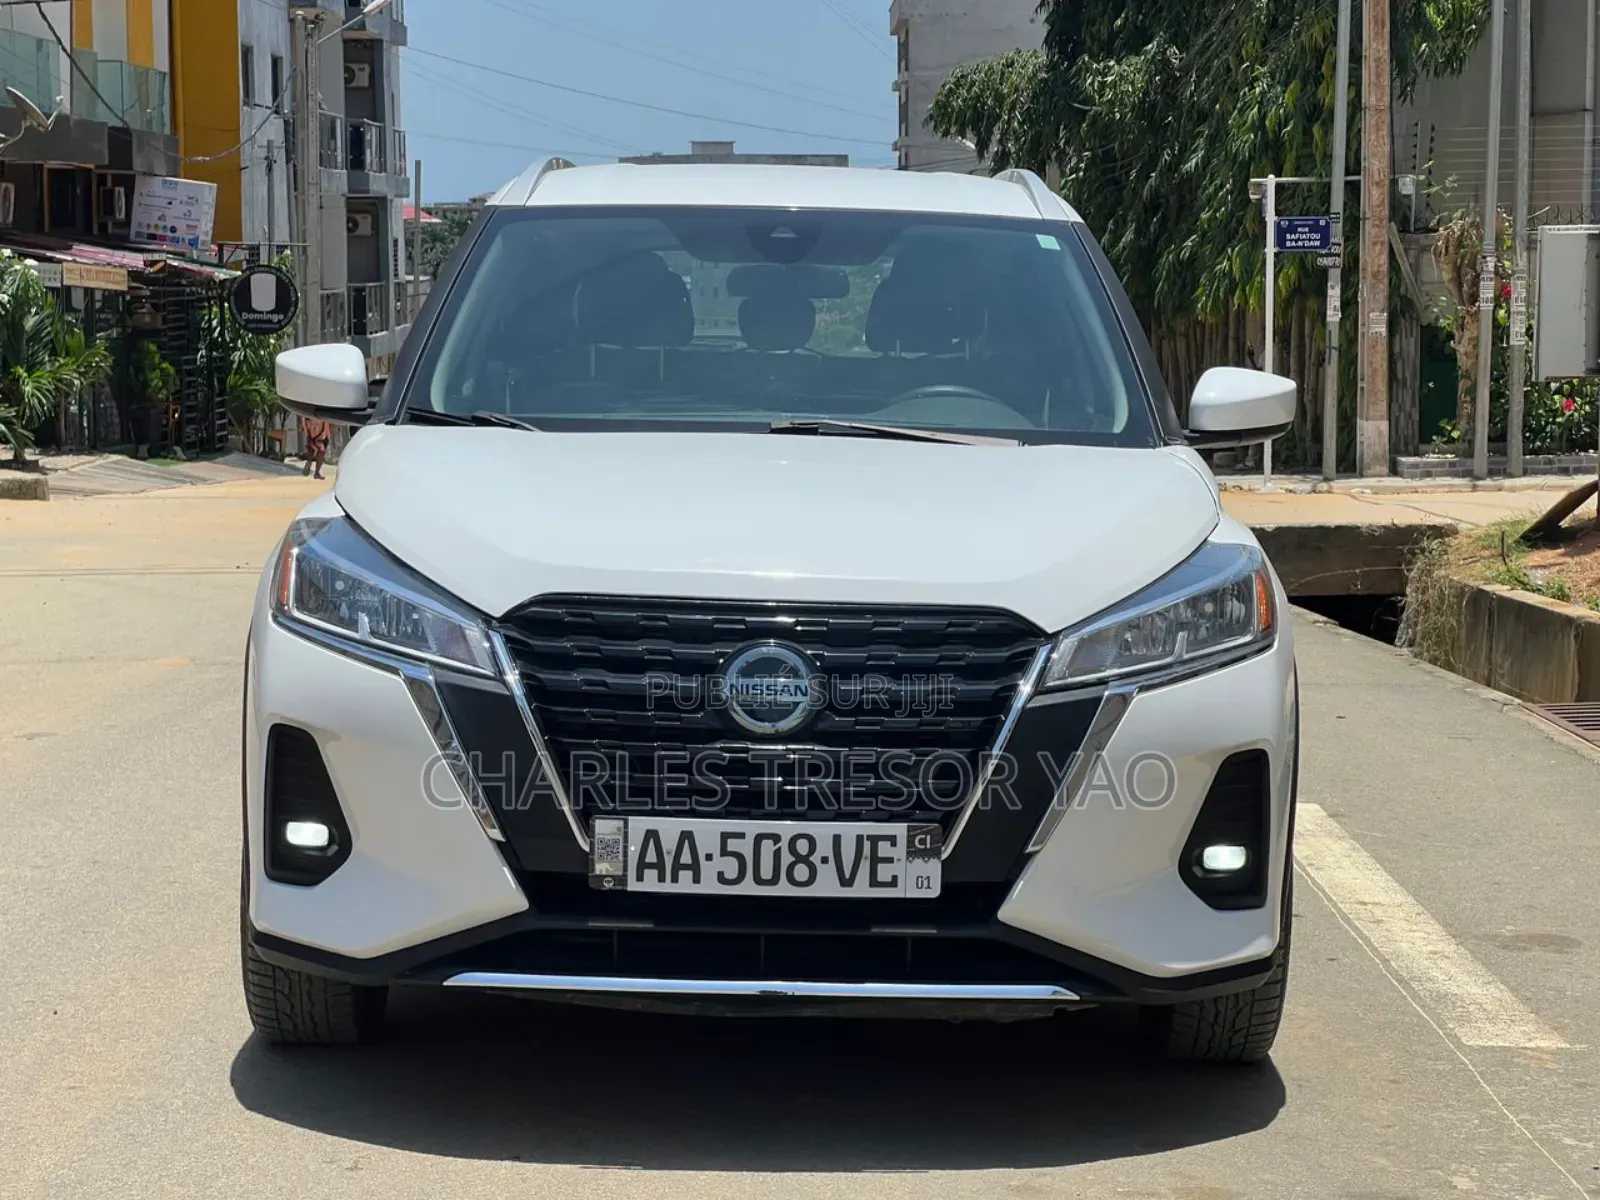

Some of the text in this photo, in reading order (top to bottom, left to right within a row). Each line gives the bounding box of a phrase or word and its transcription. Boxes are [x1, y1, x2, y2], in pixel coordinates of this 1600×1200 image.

[729, 683, 808, 697] NISSAN
[914, 834, 931, 849] CI
[915, 875, 932, 890] 01
